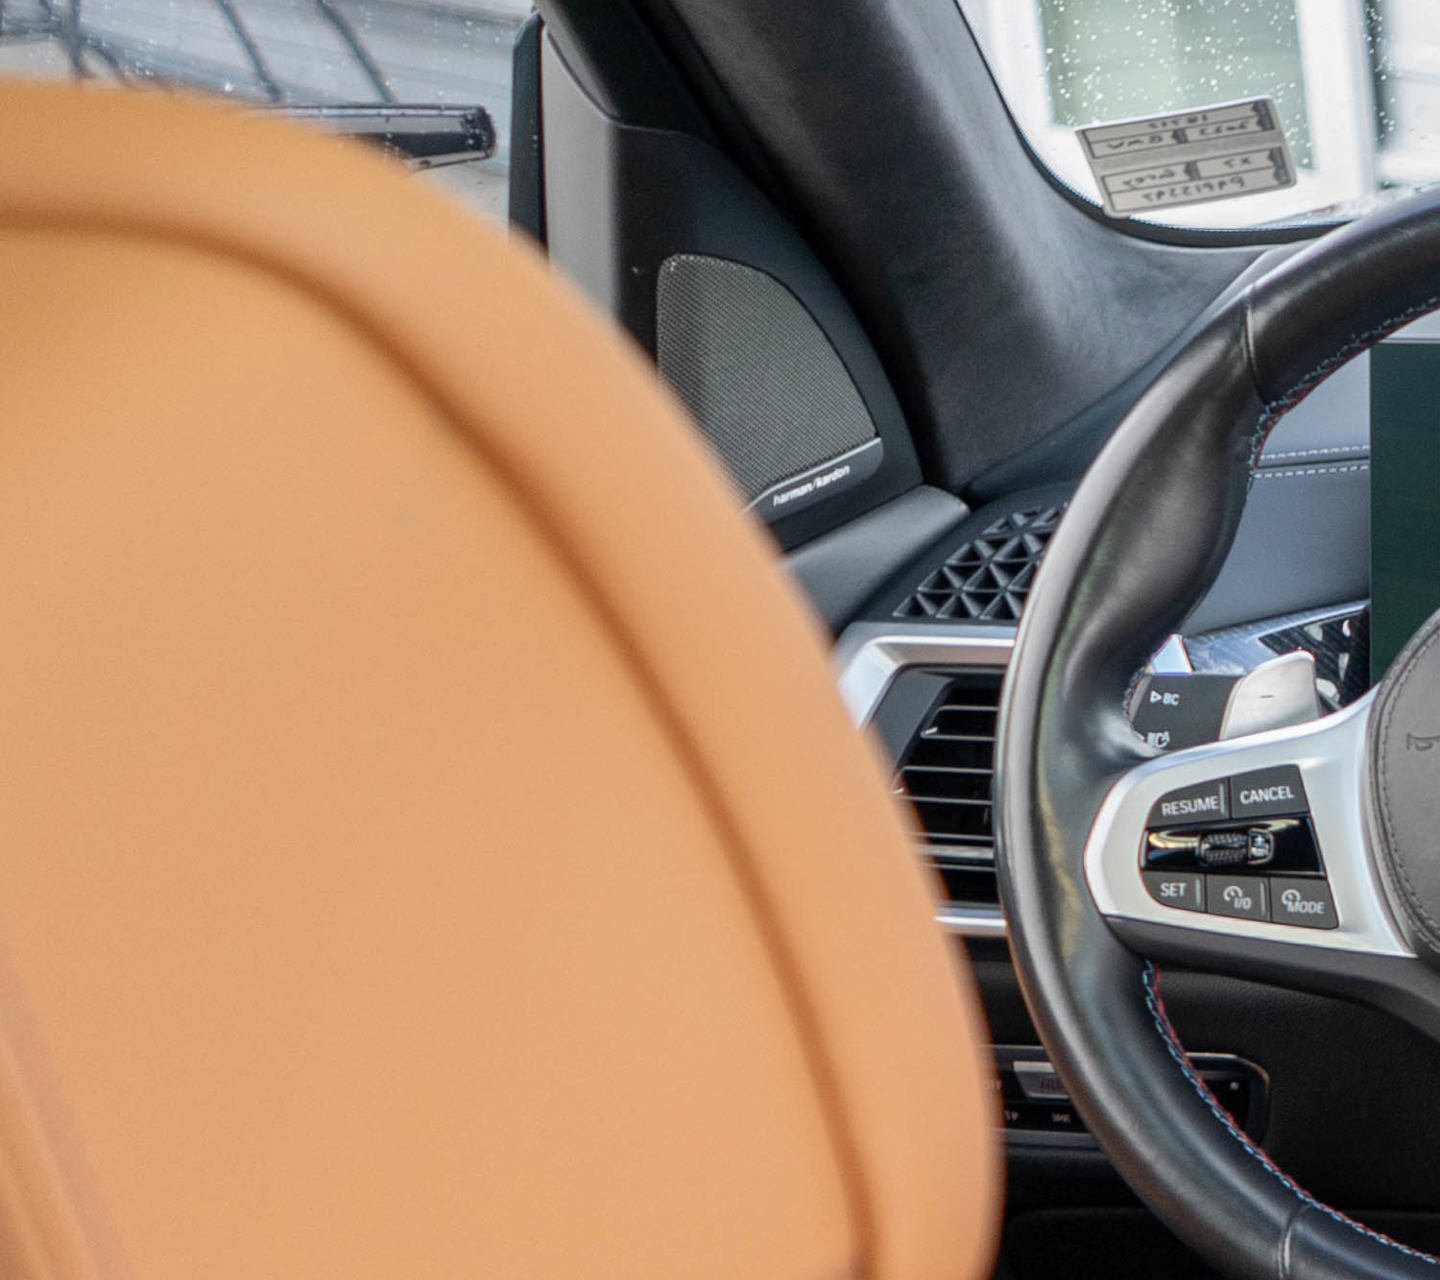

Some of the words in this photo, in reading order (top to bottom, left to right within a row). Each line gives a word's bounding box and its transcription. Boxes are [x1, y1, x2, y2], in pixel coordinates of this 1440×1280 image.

[1239, 785, 1295, 805] CANCEL
[1161, 794, 1219, 817] RESUME
[1160, 882, 1187, 897] SET
[1286, 900, 1326, 915] MODE
